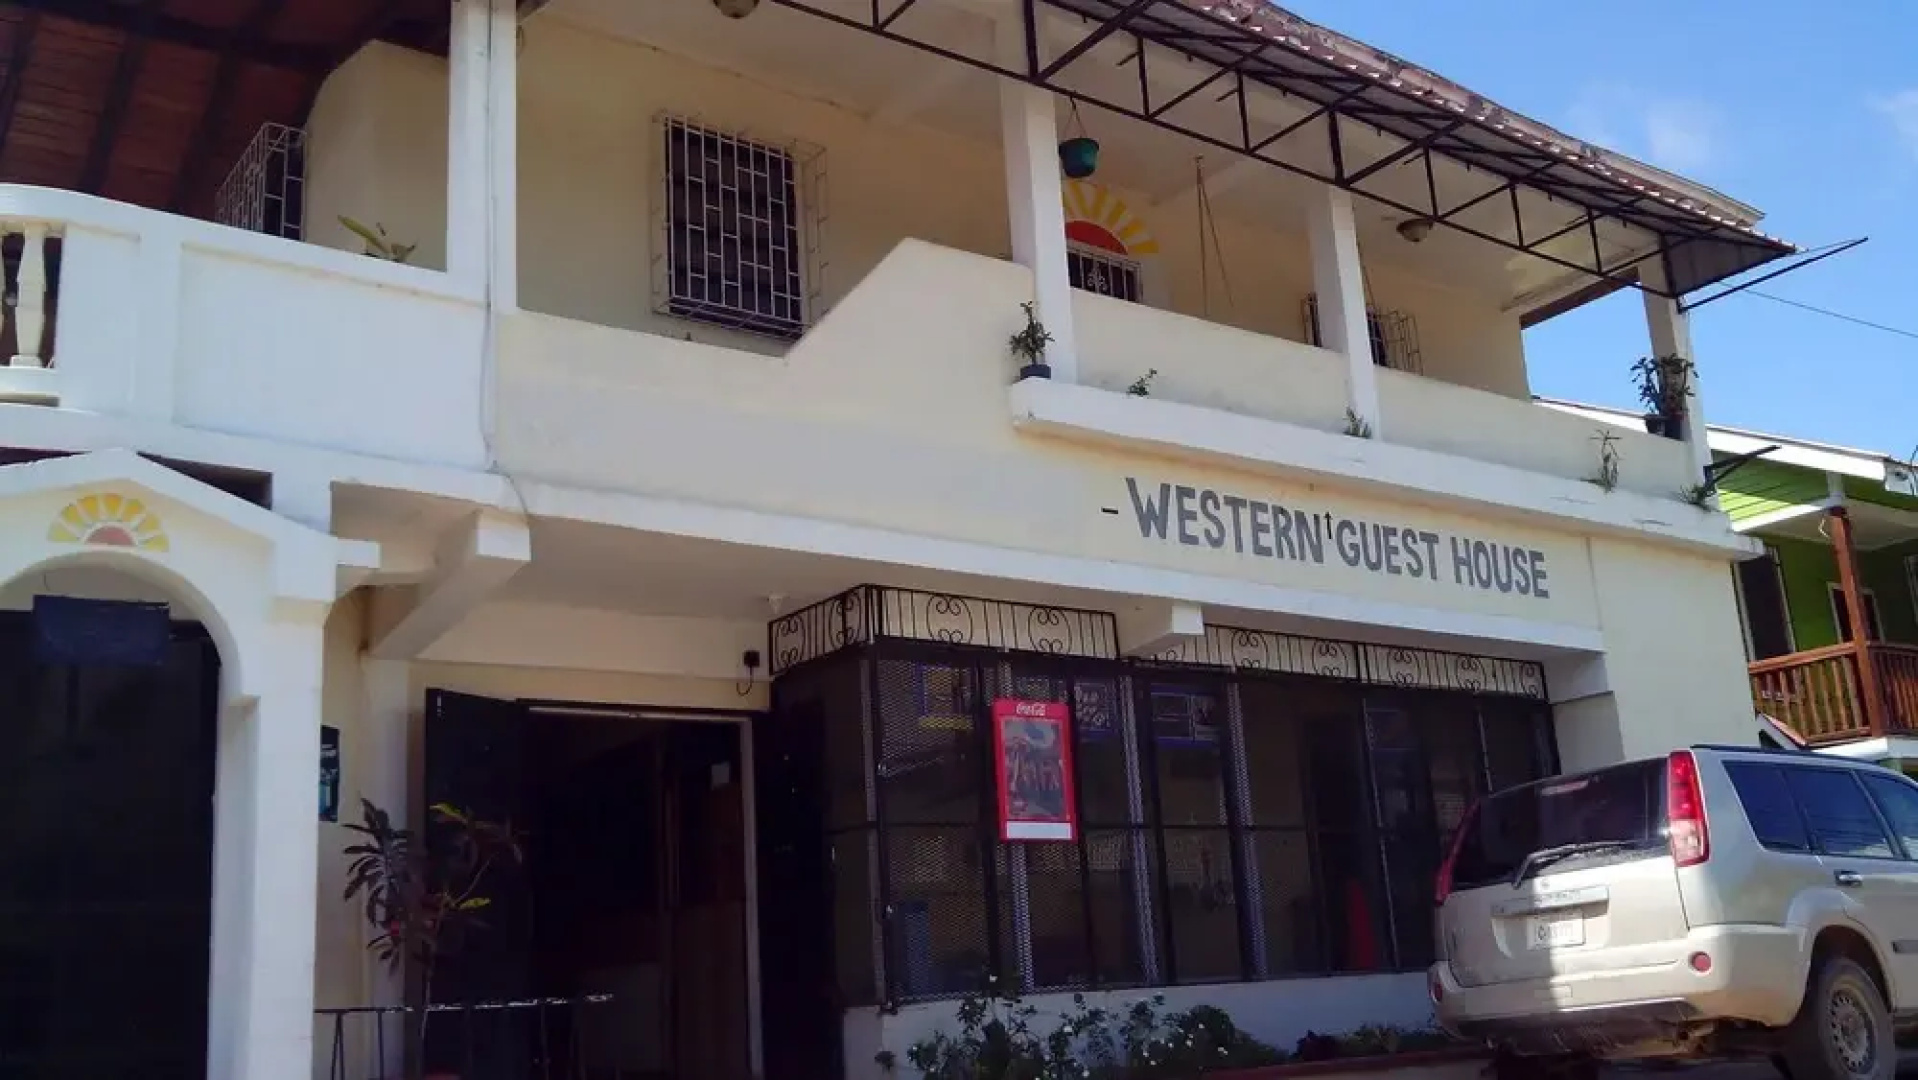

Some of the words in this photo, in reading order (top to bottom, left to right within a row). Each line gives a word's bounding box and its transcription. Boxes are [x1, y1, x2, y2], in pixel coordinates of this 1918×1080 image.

[1126, 477, 1324, 563] WESTERN
[1335, 519, 1439, 580] GUEST
[1450, 537, 1549, 598] HOUSE
